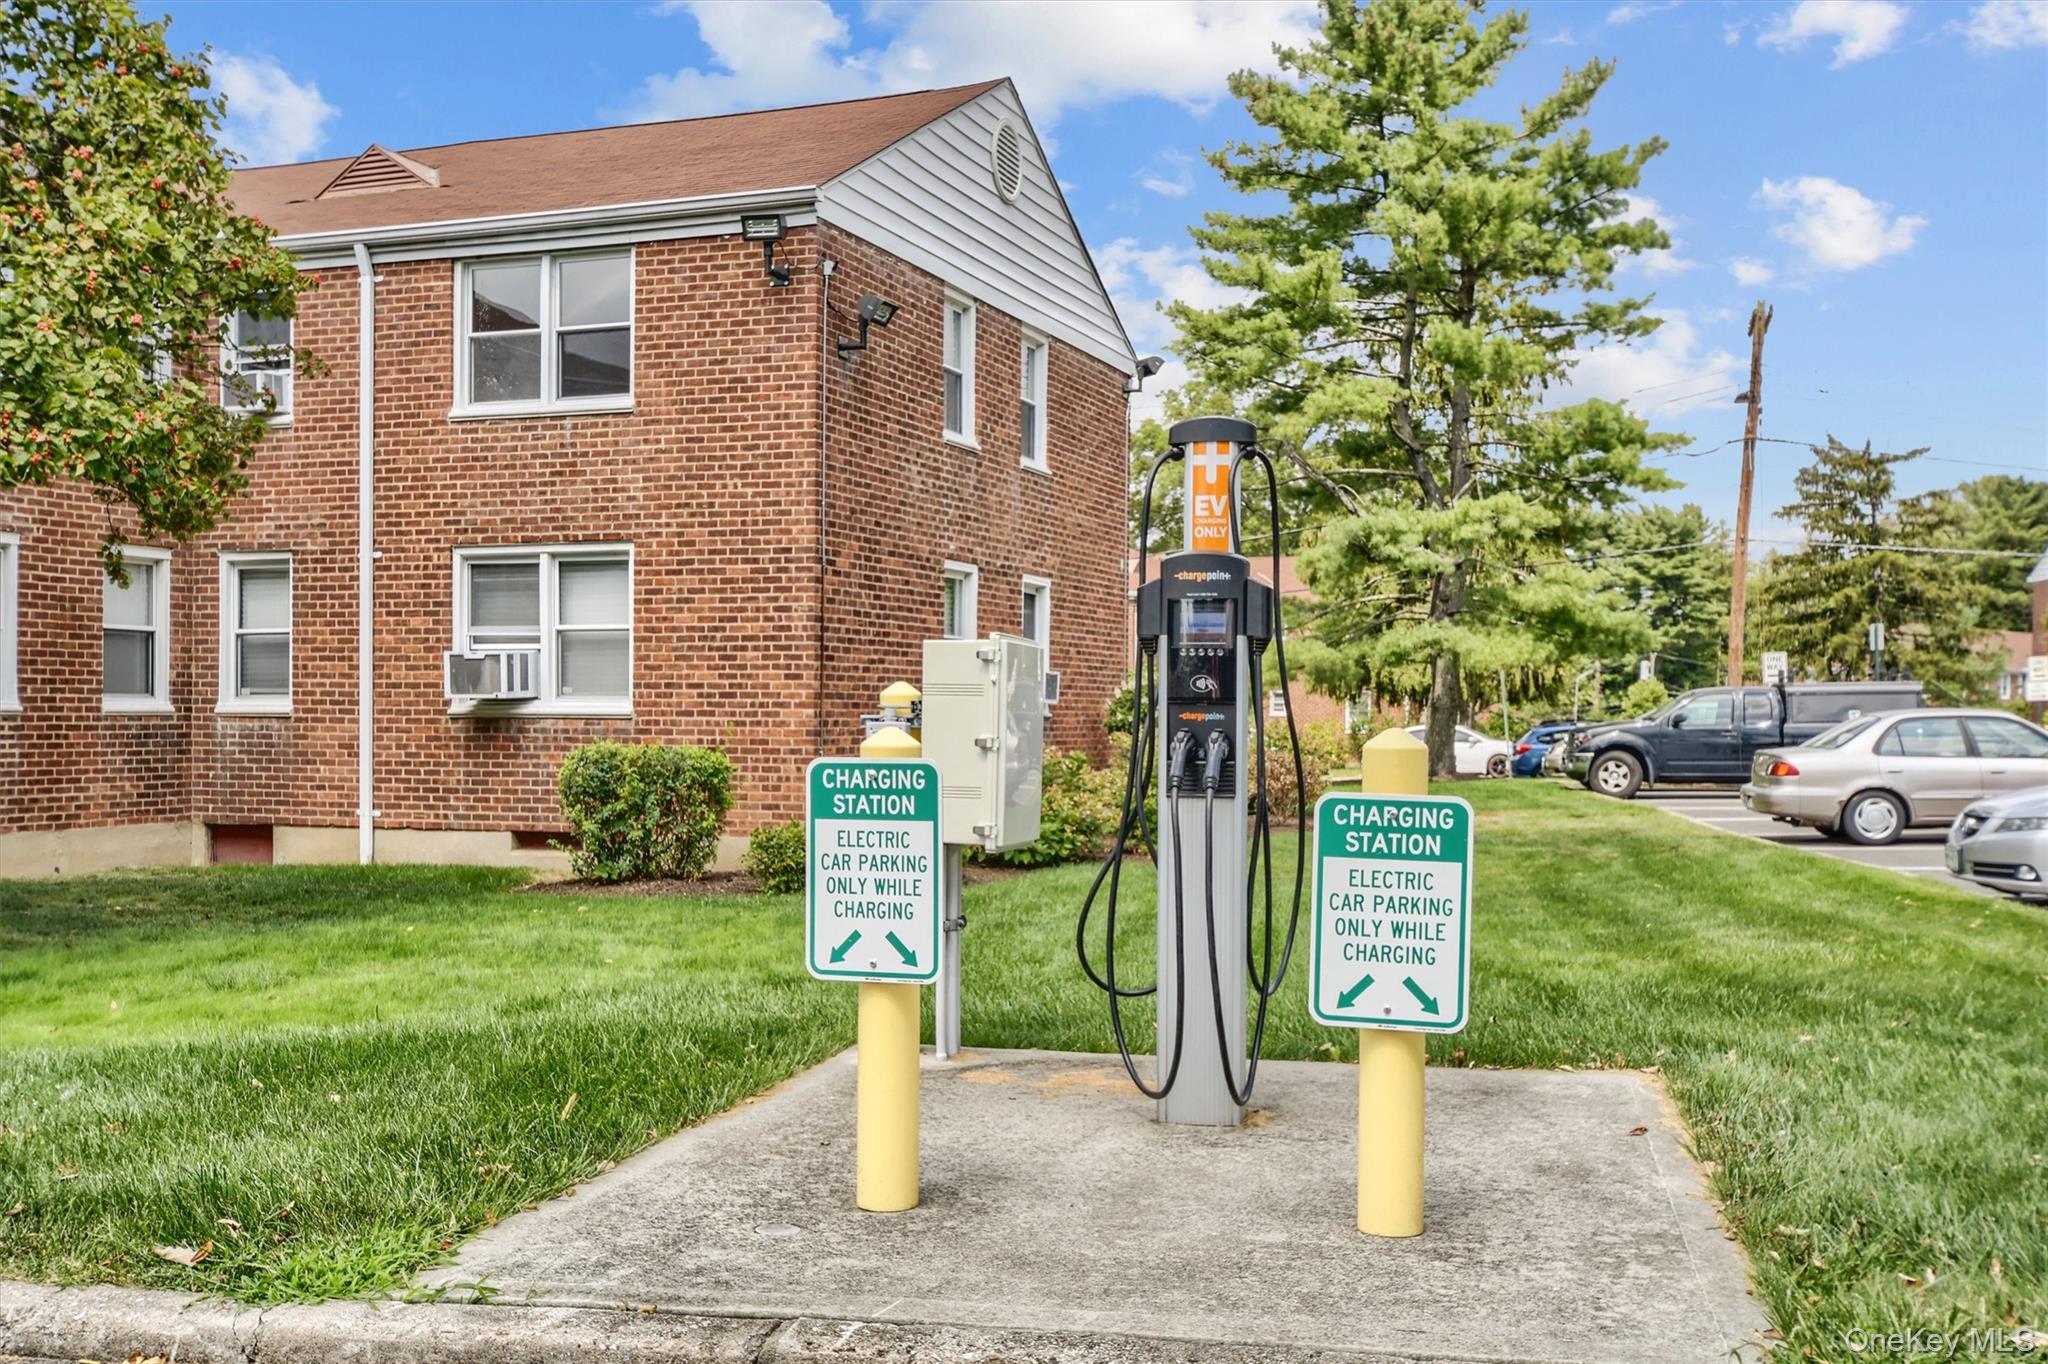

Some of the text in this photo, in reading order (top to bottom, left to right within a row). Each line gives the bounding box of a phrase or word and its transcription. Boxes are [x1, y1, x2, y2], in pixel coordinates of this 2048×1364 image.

[1194, 495, 1228, 516] EV
[1194, 526, 1228, 538] ONLY
[1766, 663, 1784, 671] WAY
[822, 768, 926, 790] CHARGING
[833, 794, 915, 815] STATION
[1333, 804, 1454, 829] CHARGING
[837, 830, 911, 849] ELECTRIC
[1345, 831, 1441, 856] STATION
[821, 853, 928, 873] CAR PARKING
[826, 876, 922, 897] ONLY WHILE
[1349, 869, 1434, 891] ELECTRIC
[834, 900, 914, 920] CHARGING
[1329, 893, 1453, 917] CAR PARKING
[1335, 918, 1446, 941] ONLY WHILE
[1343, 943, 1436, 966] CHARGING
